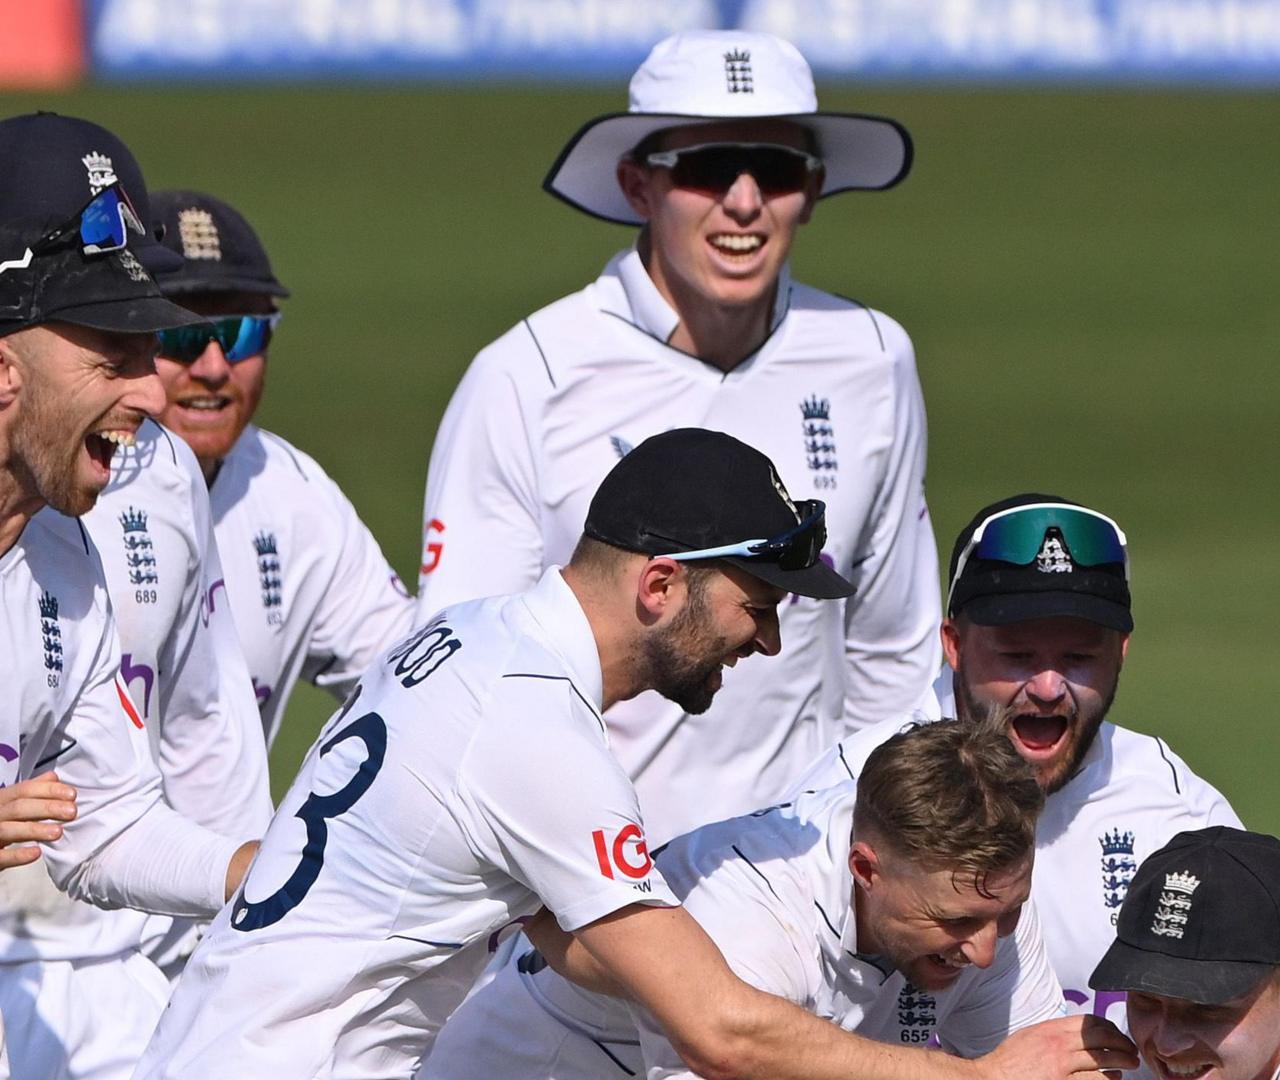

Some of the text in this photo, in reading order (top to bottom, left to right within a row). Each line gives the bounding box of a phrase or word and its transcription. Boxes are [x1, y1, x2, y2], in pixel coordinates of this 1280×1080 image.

[135, 590, 157, 604] 689
[592, 824, 652, 880] IG
[900, 1029, 930, 1043] 655
